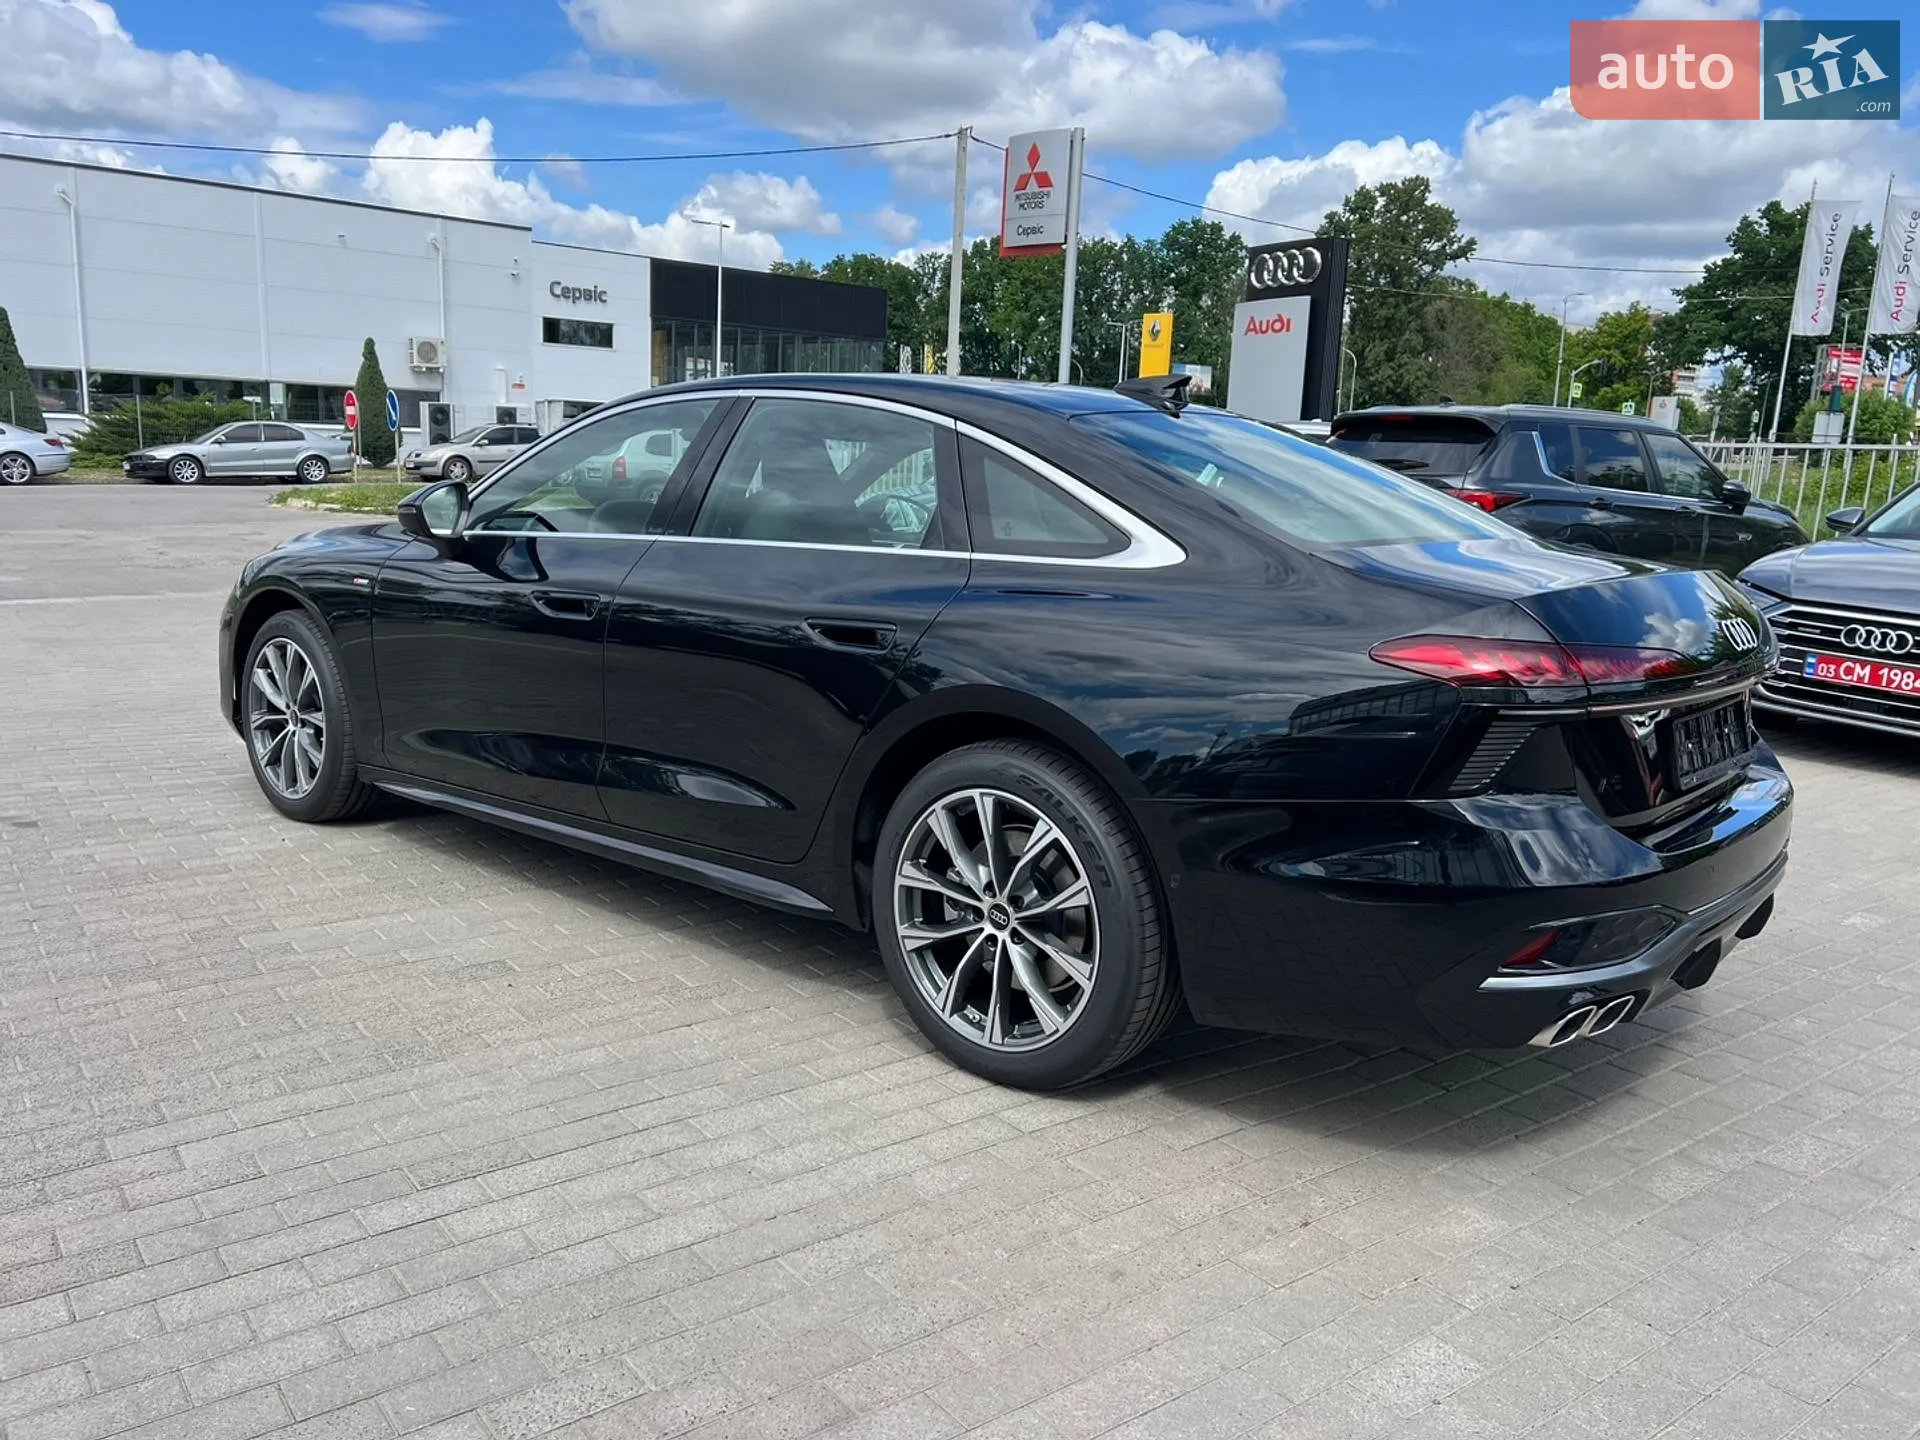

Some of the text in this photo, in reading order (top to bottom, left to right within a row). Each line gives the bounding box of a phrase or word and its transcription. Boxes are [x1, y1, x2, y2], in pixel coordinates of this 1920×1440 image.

[1018, 200, 1045, 210] MOTORS
[1017, 222, 1044, 238] Сервіс
[1819, 212, 1842, 277] Service
[1890, 210, 1919, 322] Audi Service
[549, 281, 608, 304] Сервіс
[1244, 313, 1292, 336] Audi
[1817, 662, 1836, 678] 03
[1839, 661, 1871, 683] CM
